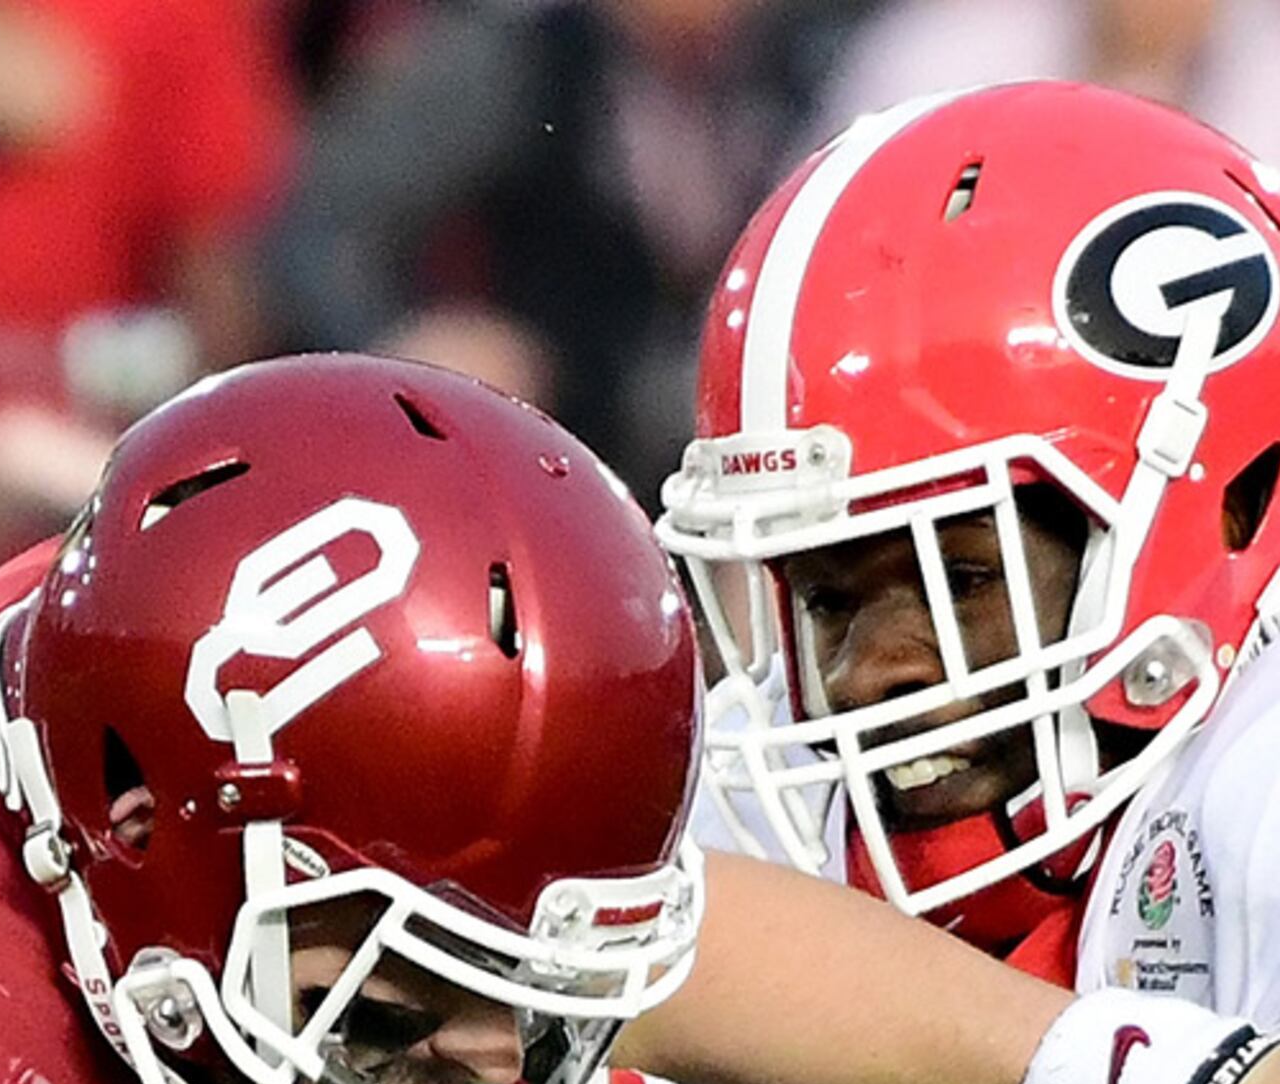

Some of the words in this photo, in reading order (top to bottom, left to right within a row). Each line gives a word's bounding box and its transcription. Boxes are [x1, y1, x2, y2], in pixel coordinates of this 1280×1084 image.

[1065, 201, 1272, 369] G
[721, 449, 797, 475] DAWGS
[184, 494, 420, 743] OU
[1187, 829, 1215, 917] GAME
